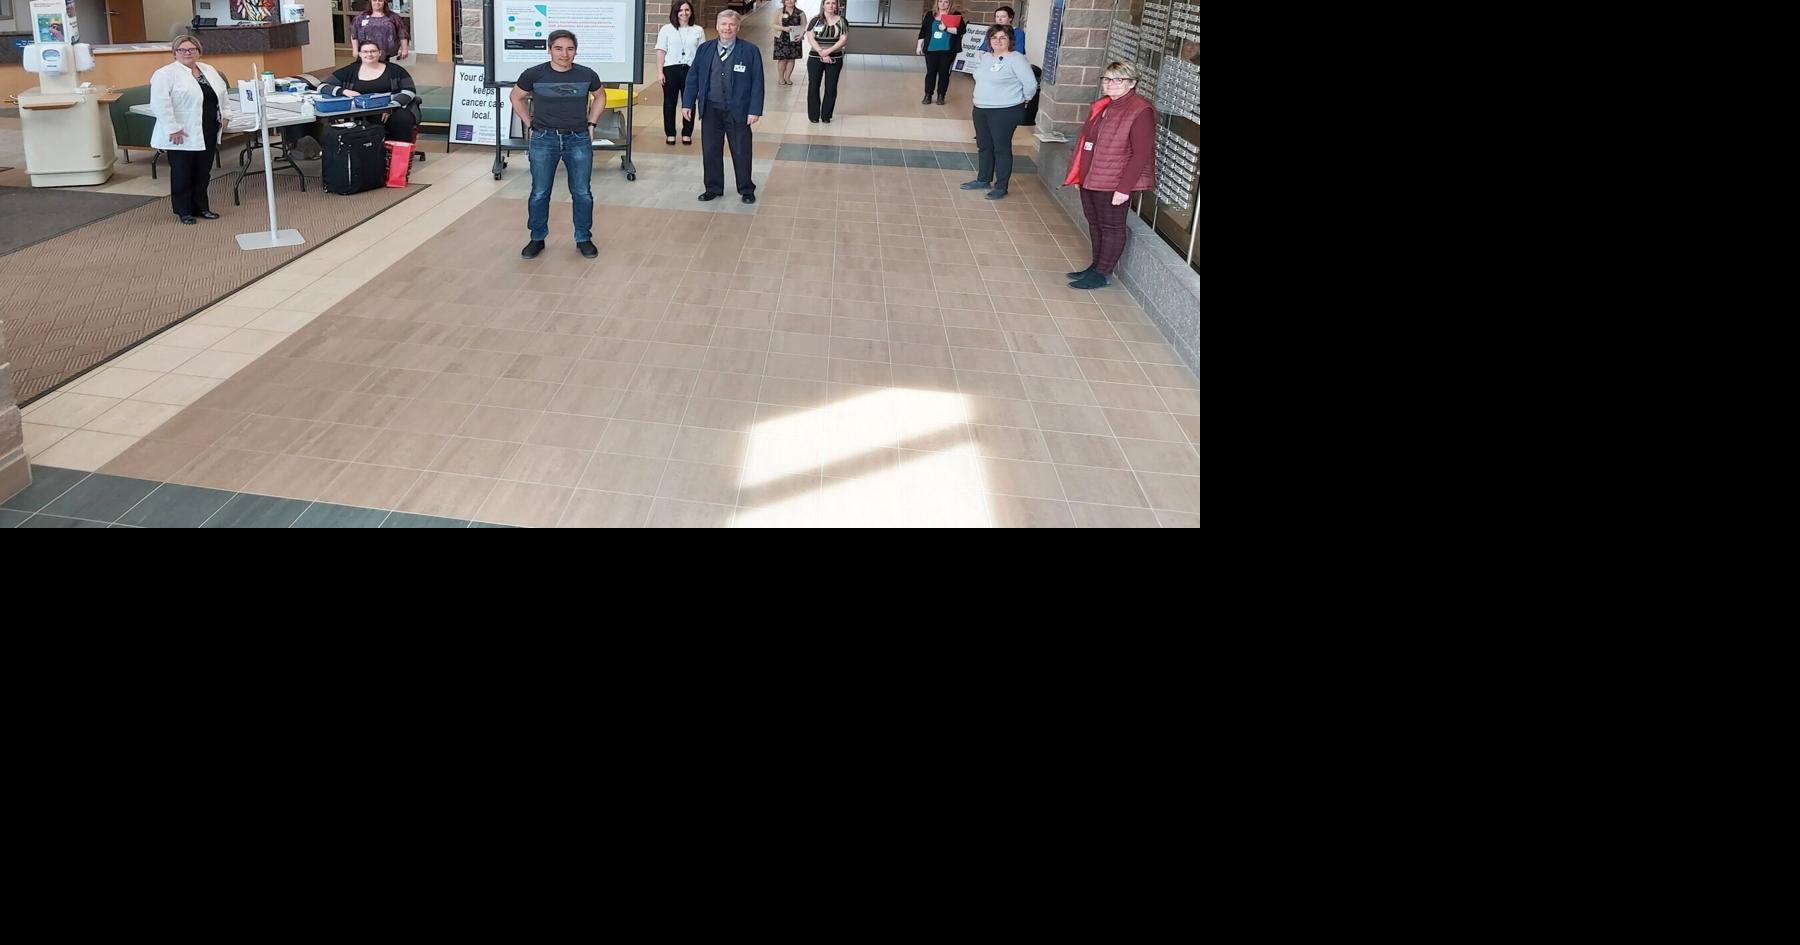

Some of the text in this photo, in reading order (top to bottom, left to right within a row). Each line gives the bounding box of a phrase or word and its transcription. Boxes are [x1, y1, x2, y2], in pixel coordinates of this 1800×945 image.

[459, 71, 477, 82] Your
[473, 85, 495, 97] keeps
[461, 98, 505, 109] cancer cae
[471, 110, 492, 120] local.
